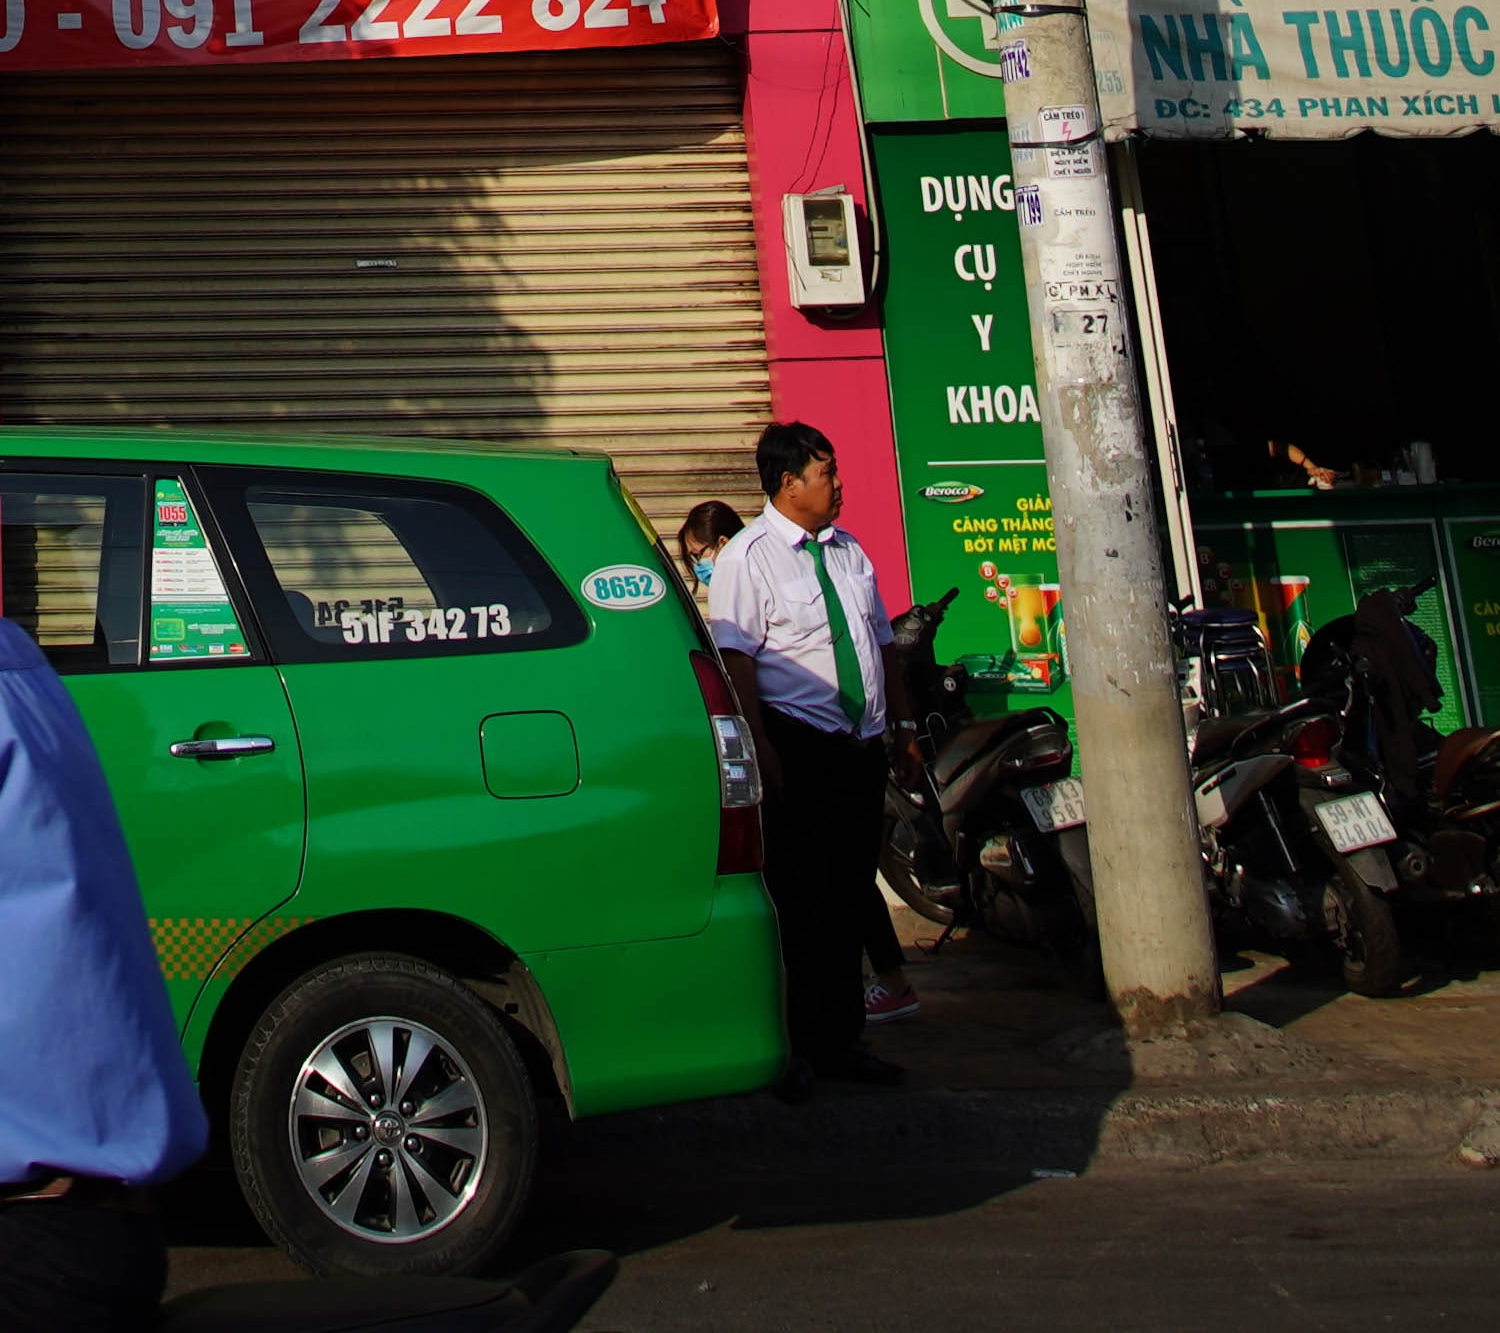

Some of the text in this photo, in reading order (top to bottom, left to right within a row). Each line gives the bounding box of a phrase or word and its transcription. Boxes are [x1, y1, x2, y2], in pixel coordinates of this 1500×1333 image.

[1154, 98, 1211, 120] ĐC:
[1221, 96, 1286, 120] 434
[1297, 95, 1389, 118] PHAN
[1401, 87, 1479, 117] XÍCH
[920, 175, 1015, 222] DỤNG
[954, 244, 998, 291] CỤ
[971, 314, 994, 352] Y
[1082, 314, 1109, 334] 27
[946, 384, 1042, 425] KHOA
[925, 485, 971, 499] Berocca
[158, 505, 188, 523] 1055
[953, 515, 999, 534] CĂNG
[963, 533, 1034, 555] BỚT MỆT
[593, 574, 656, 601] 8652
[340, 603, 513, 645] 51F 342 73
[1326, 799, 1373, 826] 59-N1
